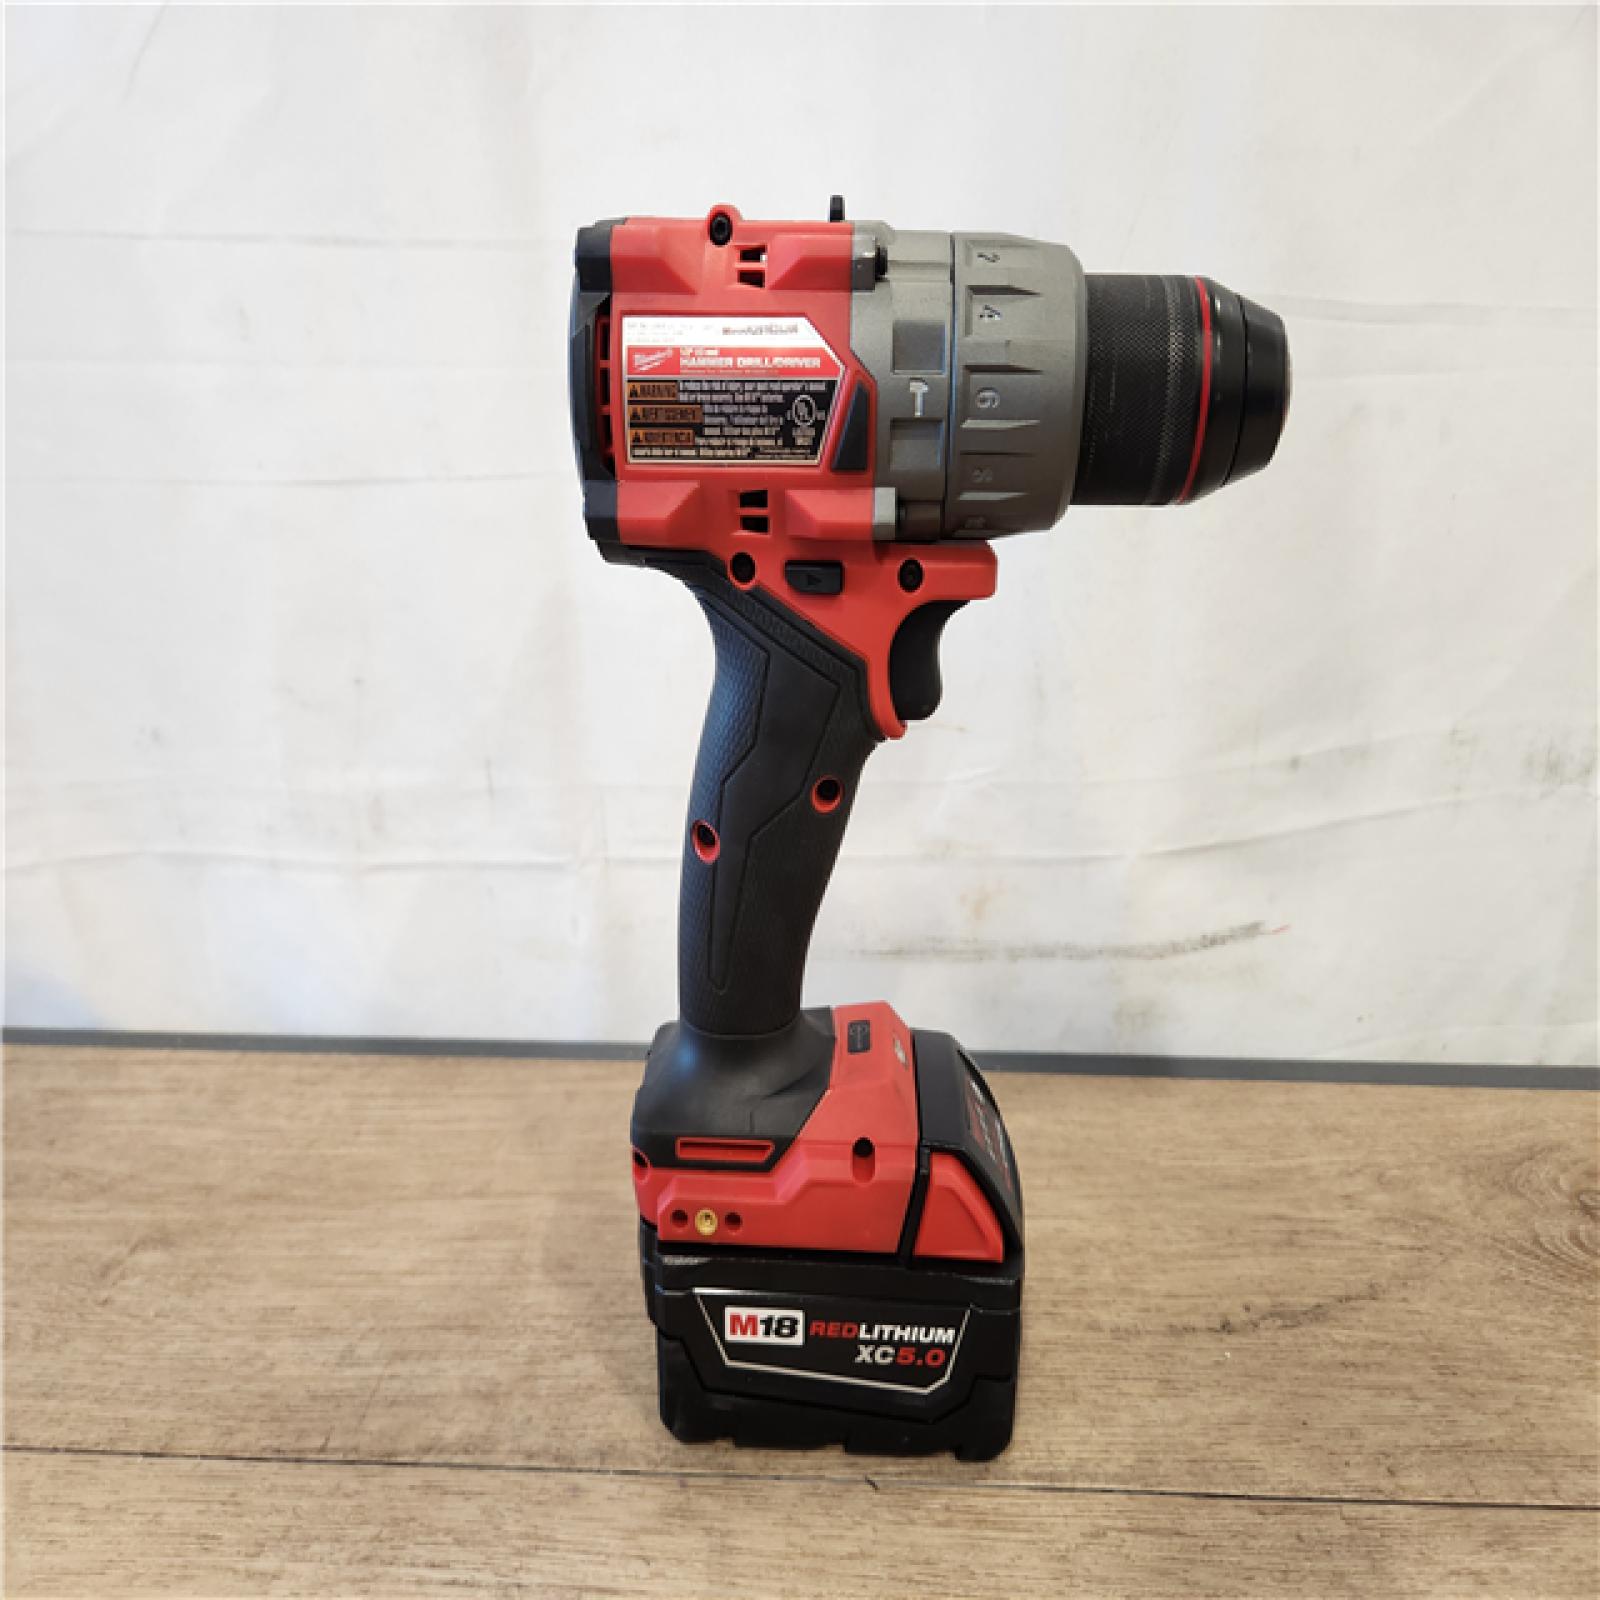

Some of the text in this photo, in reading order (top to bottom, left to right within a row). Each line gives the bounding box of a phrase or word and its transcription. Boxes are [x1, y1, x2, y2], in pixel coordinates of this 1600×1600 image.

[979, 304, 1002, 320] 4
[680, 356, 821, 369] HAMMER DRILL/DRIVER
[977, 386, 1000, 409] 6
[729, 1314, 956, 1345] M18 REDLITHIUM
[854, 1344, 946, 1367] XC5.0
